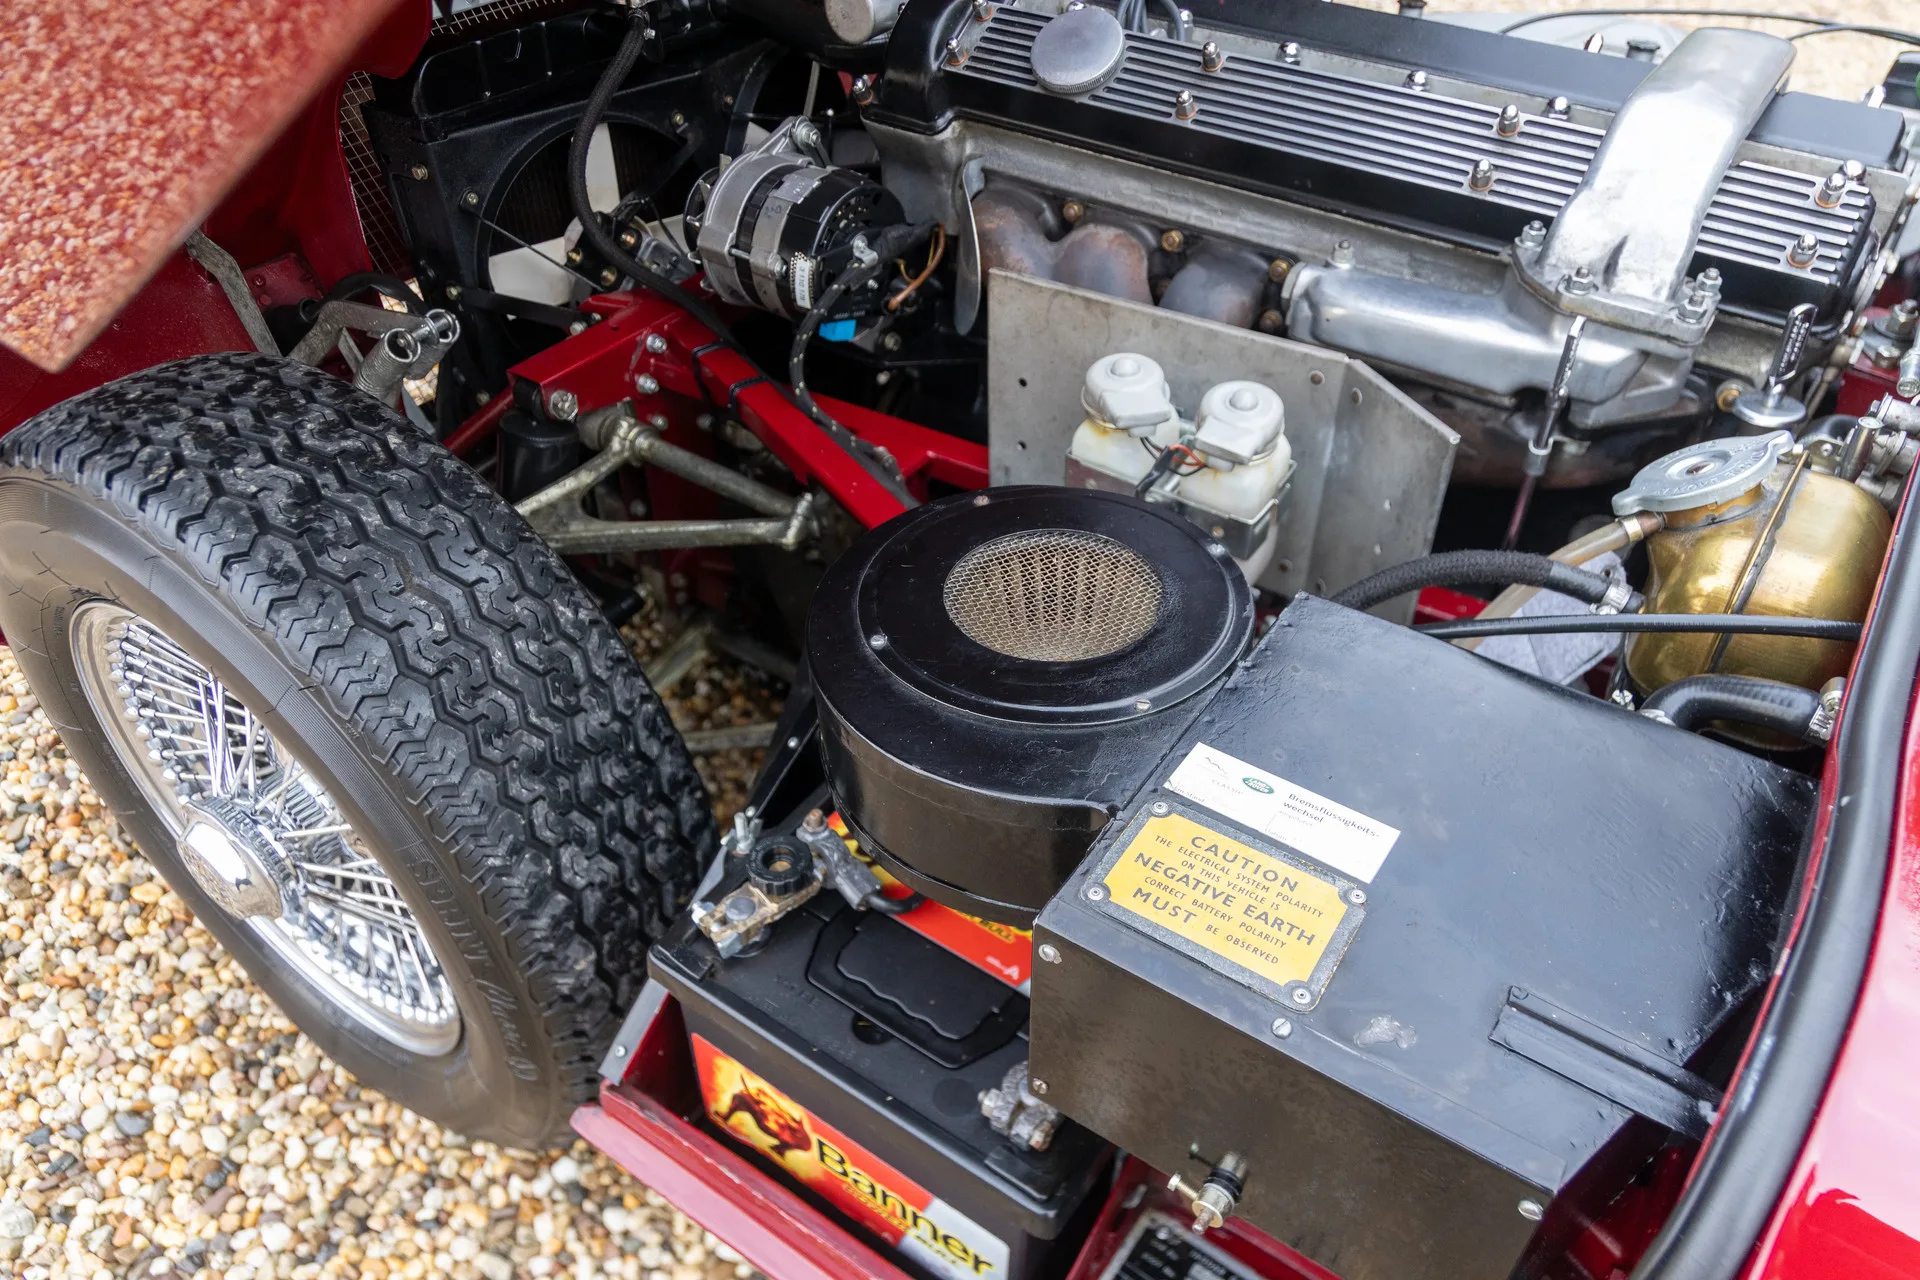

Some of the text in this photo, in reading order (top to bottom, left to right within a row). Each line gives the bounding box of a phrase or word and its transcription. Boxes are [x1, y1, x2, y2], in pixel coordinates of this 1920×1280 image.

[1283, 803, 1324, 823] wechsel
[1134, 852, 1316, 946] NEGATIVE EARTH
[1156, 835, 1324, 918] THE ELECTRICAL SYSTEM POLARITY
[1182, 860, 1280, 911] ON THIS VEHICLE IS
[1191, 836, 1299, 892] CAUTION
[1132, 887, 1279, 964] MUST BE OBSERVED
[1144, 876, 1287, 948] CORRECT BATTERY POLARITY
[816, 1137, 994, 1275] Banner
